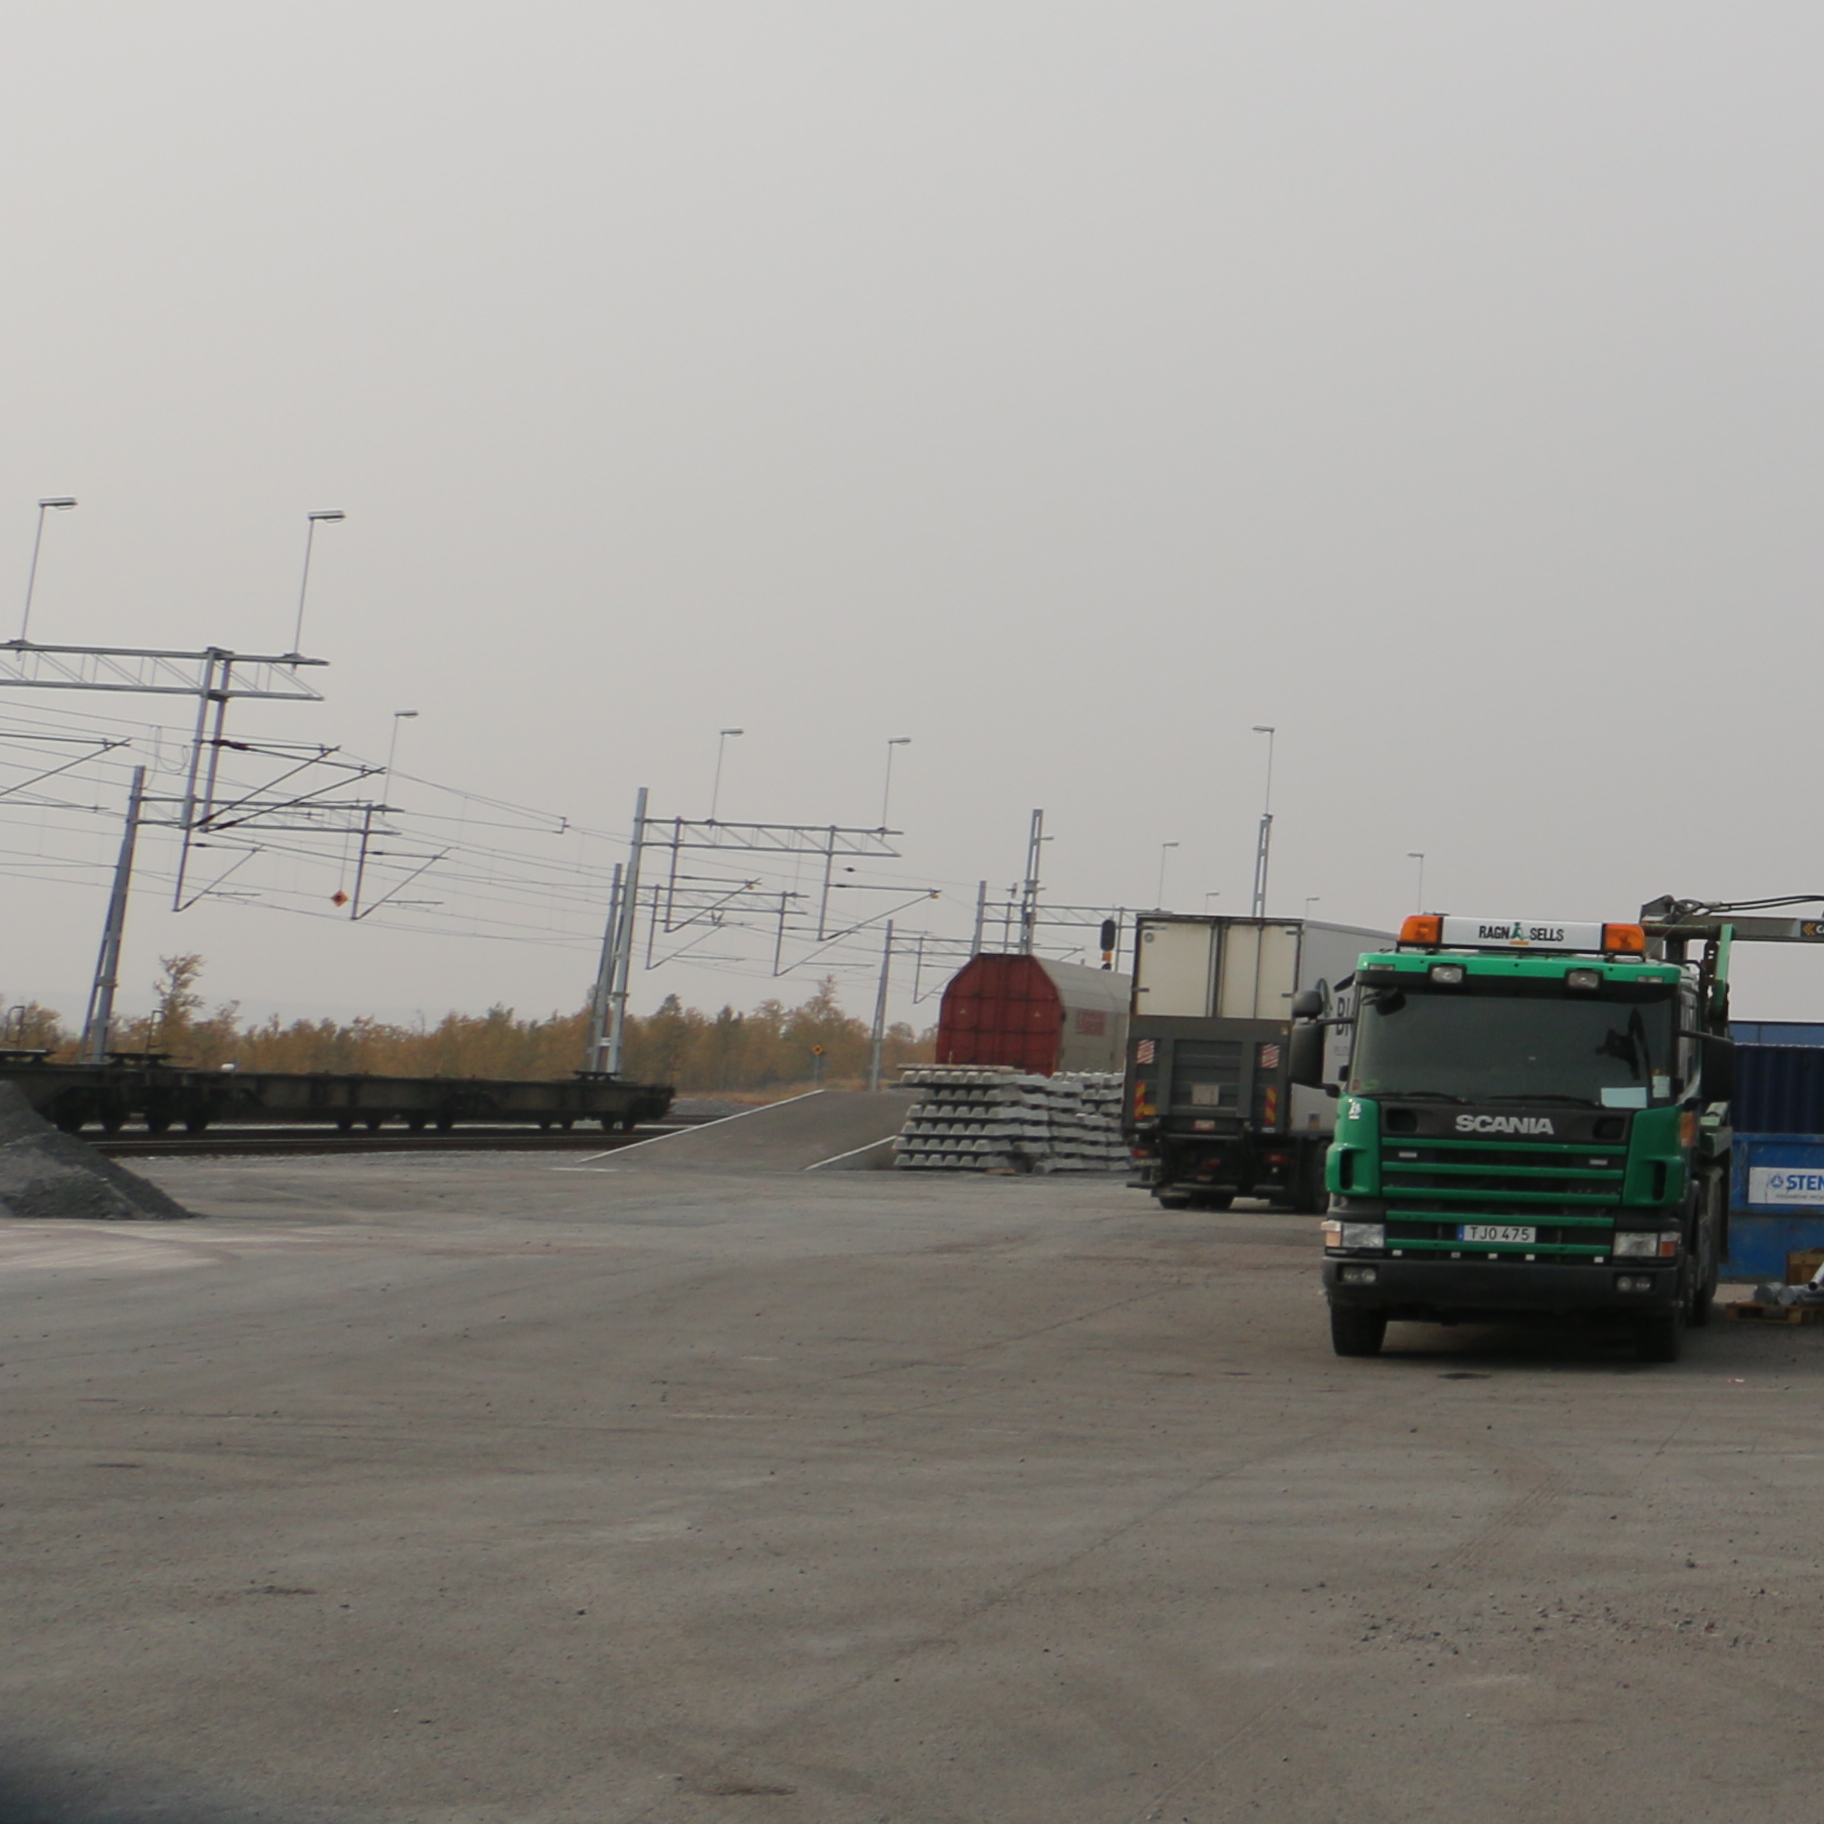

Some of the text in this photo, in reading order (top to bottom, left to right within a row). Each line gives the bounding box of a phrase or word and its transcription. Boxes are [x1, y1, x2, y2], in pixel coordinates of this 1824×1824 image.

[1479, 925, 1564, 942] RAGN SELLS
[1455, 1114, 1555, 1135] SCANIA
[1502, 1227, 1530, 1242] 475
